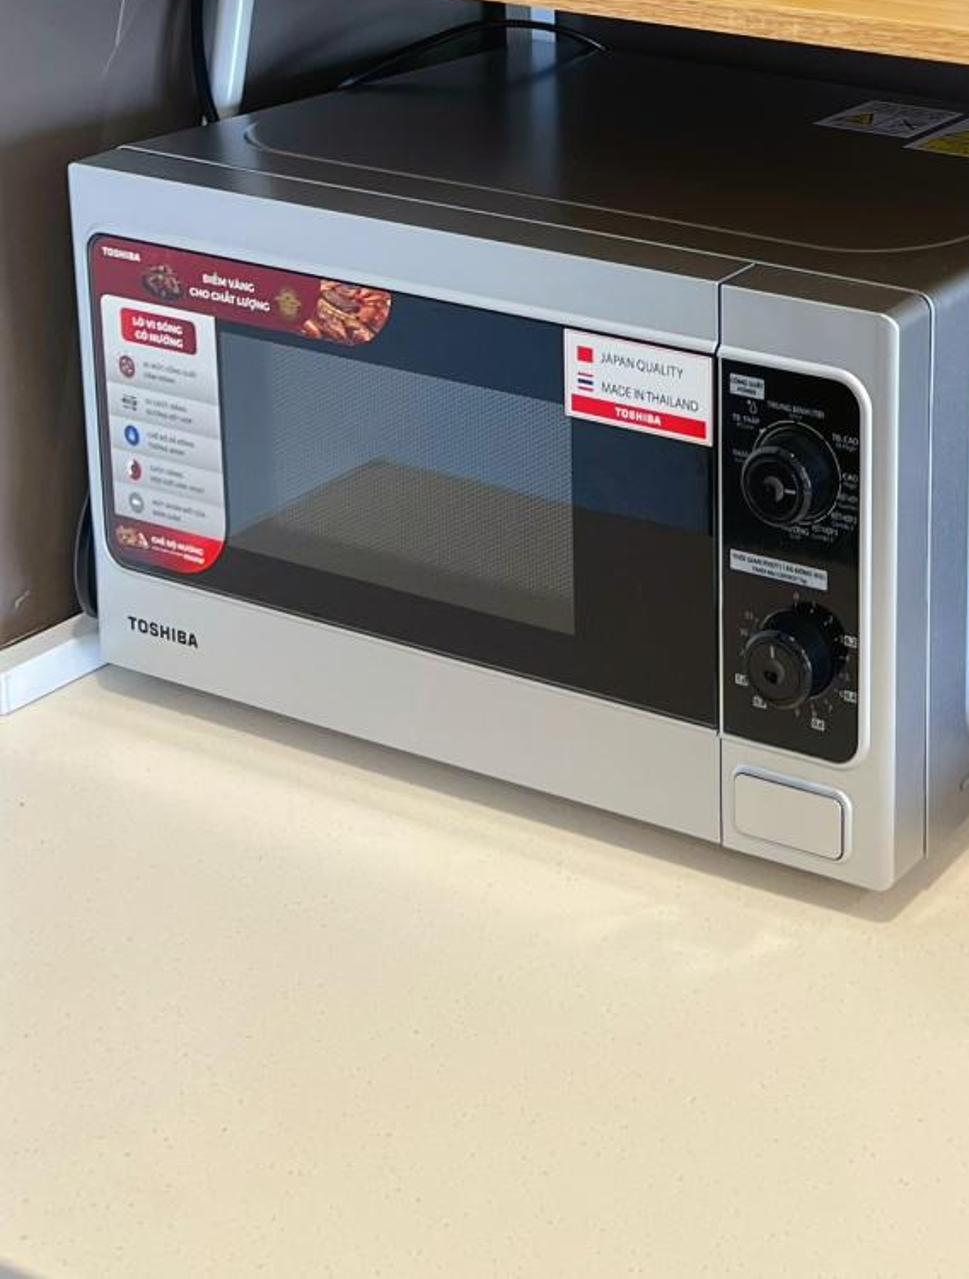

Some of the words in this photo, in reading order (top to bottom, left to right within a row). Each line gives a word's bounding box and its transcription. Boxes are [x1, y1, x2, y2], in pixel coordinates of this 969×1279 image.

[101, 246, 141, 263] TOSHIBA
[189, 286, 210, 300] CHO
[600, 351, 635, 370] JAPAN
[636, 358, 683, 379] QUALITY
[601, 382, 633, 400] MADE
[633, 388, 644, 401] IN
[647, 391, 699, 412] THAILAND
[614, 406, 662, 426] TOSHIBA
[127, 616, 199, 648] TOSHIBA
